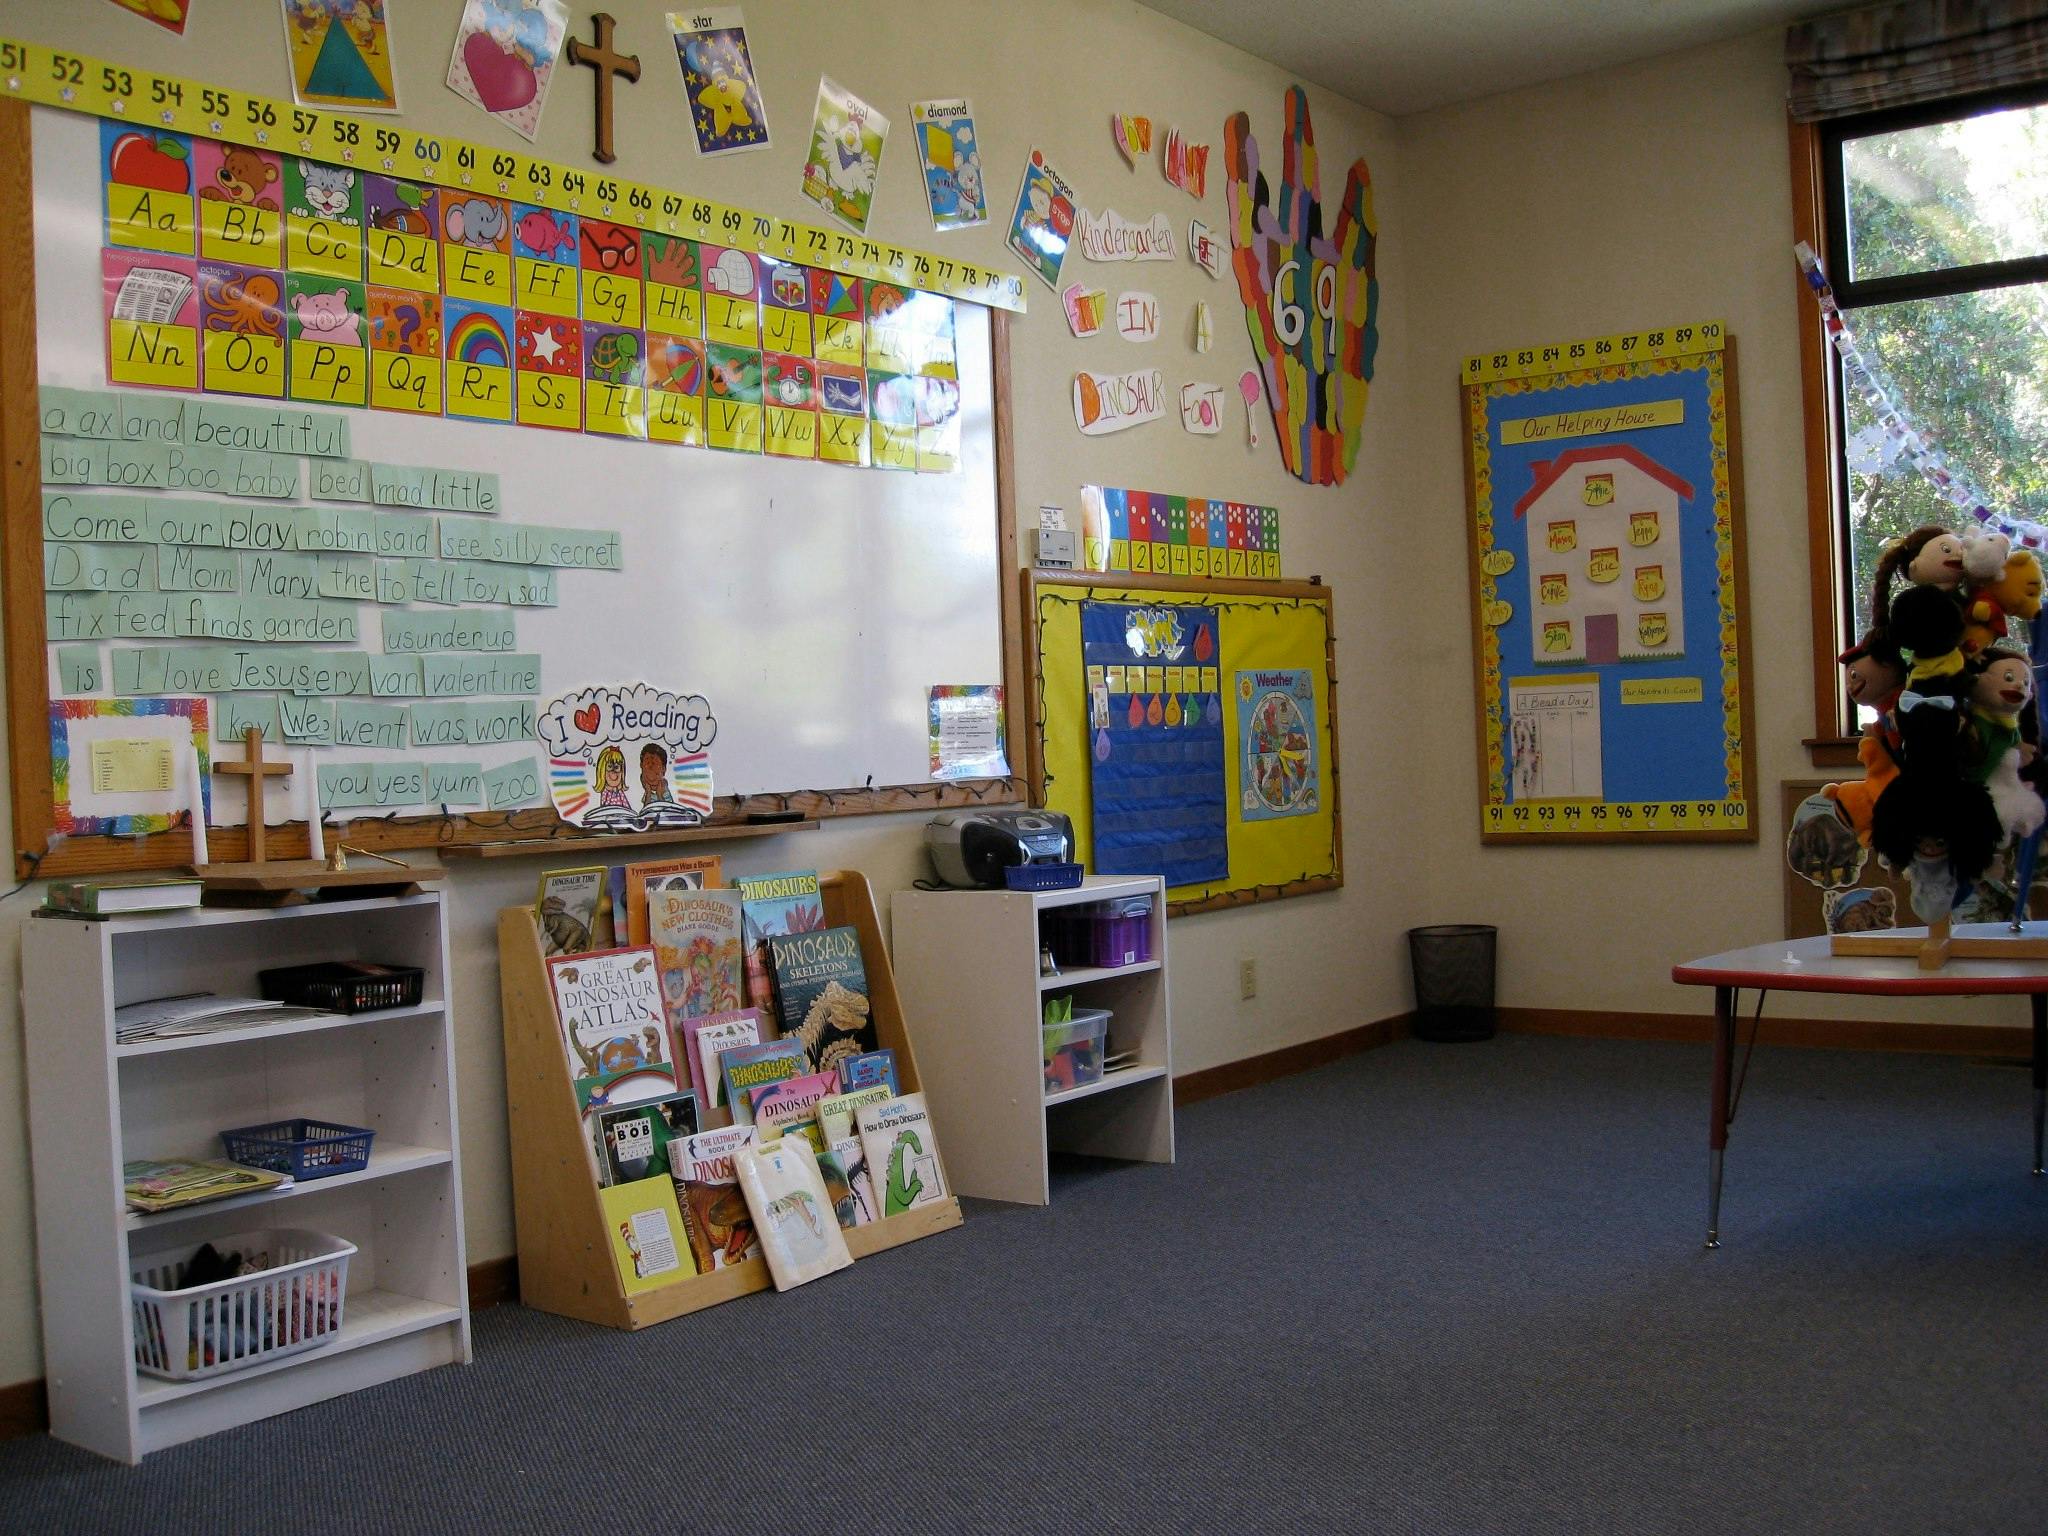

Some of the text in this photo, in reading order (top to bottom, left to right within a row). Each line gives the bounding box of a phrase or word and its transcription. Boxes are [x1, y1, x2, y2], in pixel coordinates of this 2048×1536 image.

[692, 16, 713, 29] star
[1, 43, 441, 162] 51 52 53 54 55 56 57 58 59 60
[927, 101, 968, 118] diamond
[1043, 165, 1074, 199] octagon
[1051, 204, 1071, 226] STOP
[1077, 210, 1176, 261] Kindergarten
[128, 192, 854, 352] Aa Bb Cc Dd Ee Ff Gg Hh Ii Jj Kk
[200, 265, 231, 276] octopus
[1119, 298, 1156, 334] IN
[1274, 260, 1336, 357] 69
[1470, 324, 1719, 372] 81 82 83 84 85 86 87 88 89 90
[128, 324, 860, 447] Nn Oo Pp Qq Rr Ss Tt Uu Vv Ww Xx
[1077, 372, 1166, 427] DINOSAUR
[45, 401, 344, 456] a ax and beautiful
[1523, 409, 1655, 438] Our Helping House
[51, 446, 495, 510] big box Boo baby bed mad little
[47, 497, 618, 567] Come our play robin said see silly secret
[50, 546, 144, 589] Dad
[172, 547, 233, 588] Mom
[250, 557, 313, 599] Mary
[332, 559, 370, 593] the
[379, 568, 405, 600] to
[412, 570, 456, 602] tell
[464, 570, 500, 603] toy
[1136, 544, 1275, 577] 2 3 4 5 6 7 8 9
[55, 594, 103, 637] fix
[114, 596, 167, 633] fed
[186, 599, 253, 639] finds
[263, 604, 356, 643] garden
[76, 663, 94, 692] is
[163, 652, 229, 690] love
[231, 652, 310, 690] Jesus
[373, 669, 418, 695] van
[432, 661, 537, 692] valentine
[1255, 672, 1293, 688] Weather
[1568, 694, 1589, 708] Day
[283, 699, 534, 743] We went was work
[555, 703, 700, 743] I Reading
[325, 773, 537, 805] you yes yum zoo
[1490, 803, 1745, 820] 91 92 93 94 95 96 97 98 99 100
[738, 875, 817, 900] DINOSAURS
[688, 911, 734, 930] CLOTHES
[596, 960, 614, 970] THE
[772, 932, 856, 970] DINOSAUR
[581, 967, 633, 988] GREAT
[790, 960, 848, 980] SKELETONS
[564, 980, 655, 1009] DINOSAUR
[580, 998, 649, 1029] ATLAS
[712, 1037, 752, 1050] Dinosaurs
[764, 1093, 820, 1118] DINOSAUR
[823, 1090, 889, 1116] GREAT DINOSAURS
[617, 1125, 650, 1141] BOB
[864, 1112, 926, 1133] How to Draw Dinosaurs
[700, 1132, 742, 1147] THE ULTIMATE
[708, 1145, 725, 1154] BOOK
